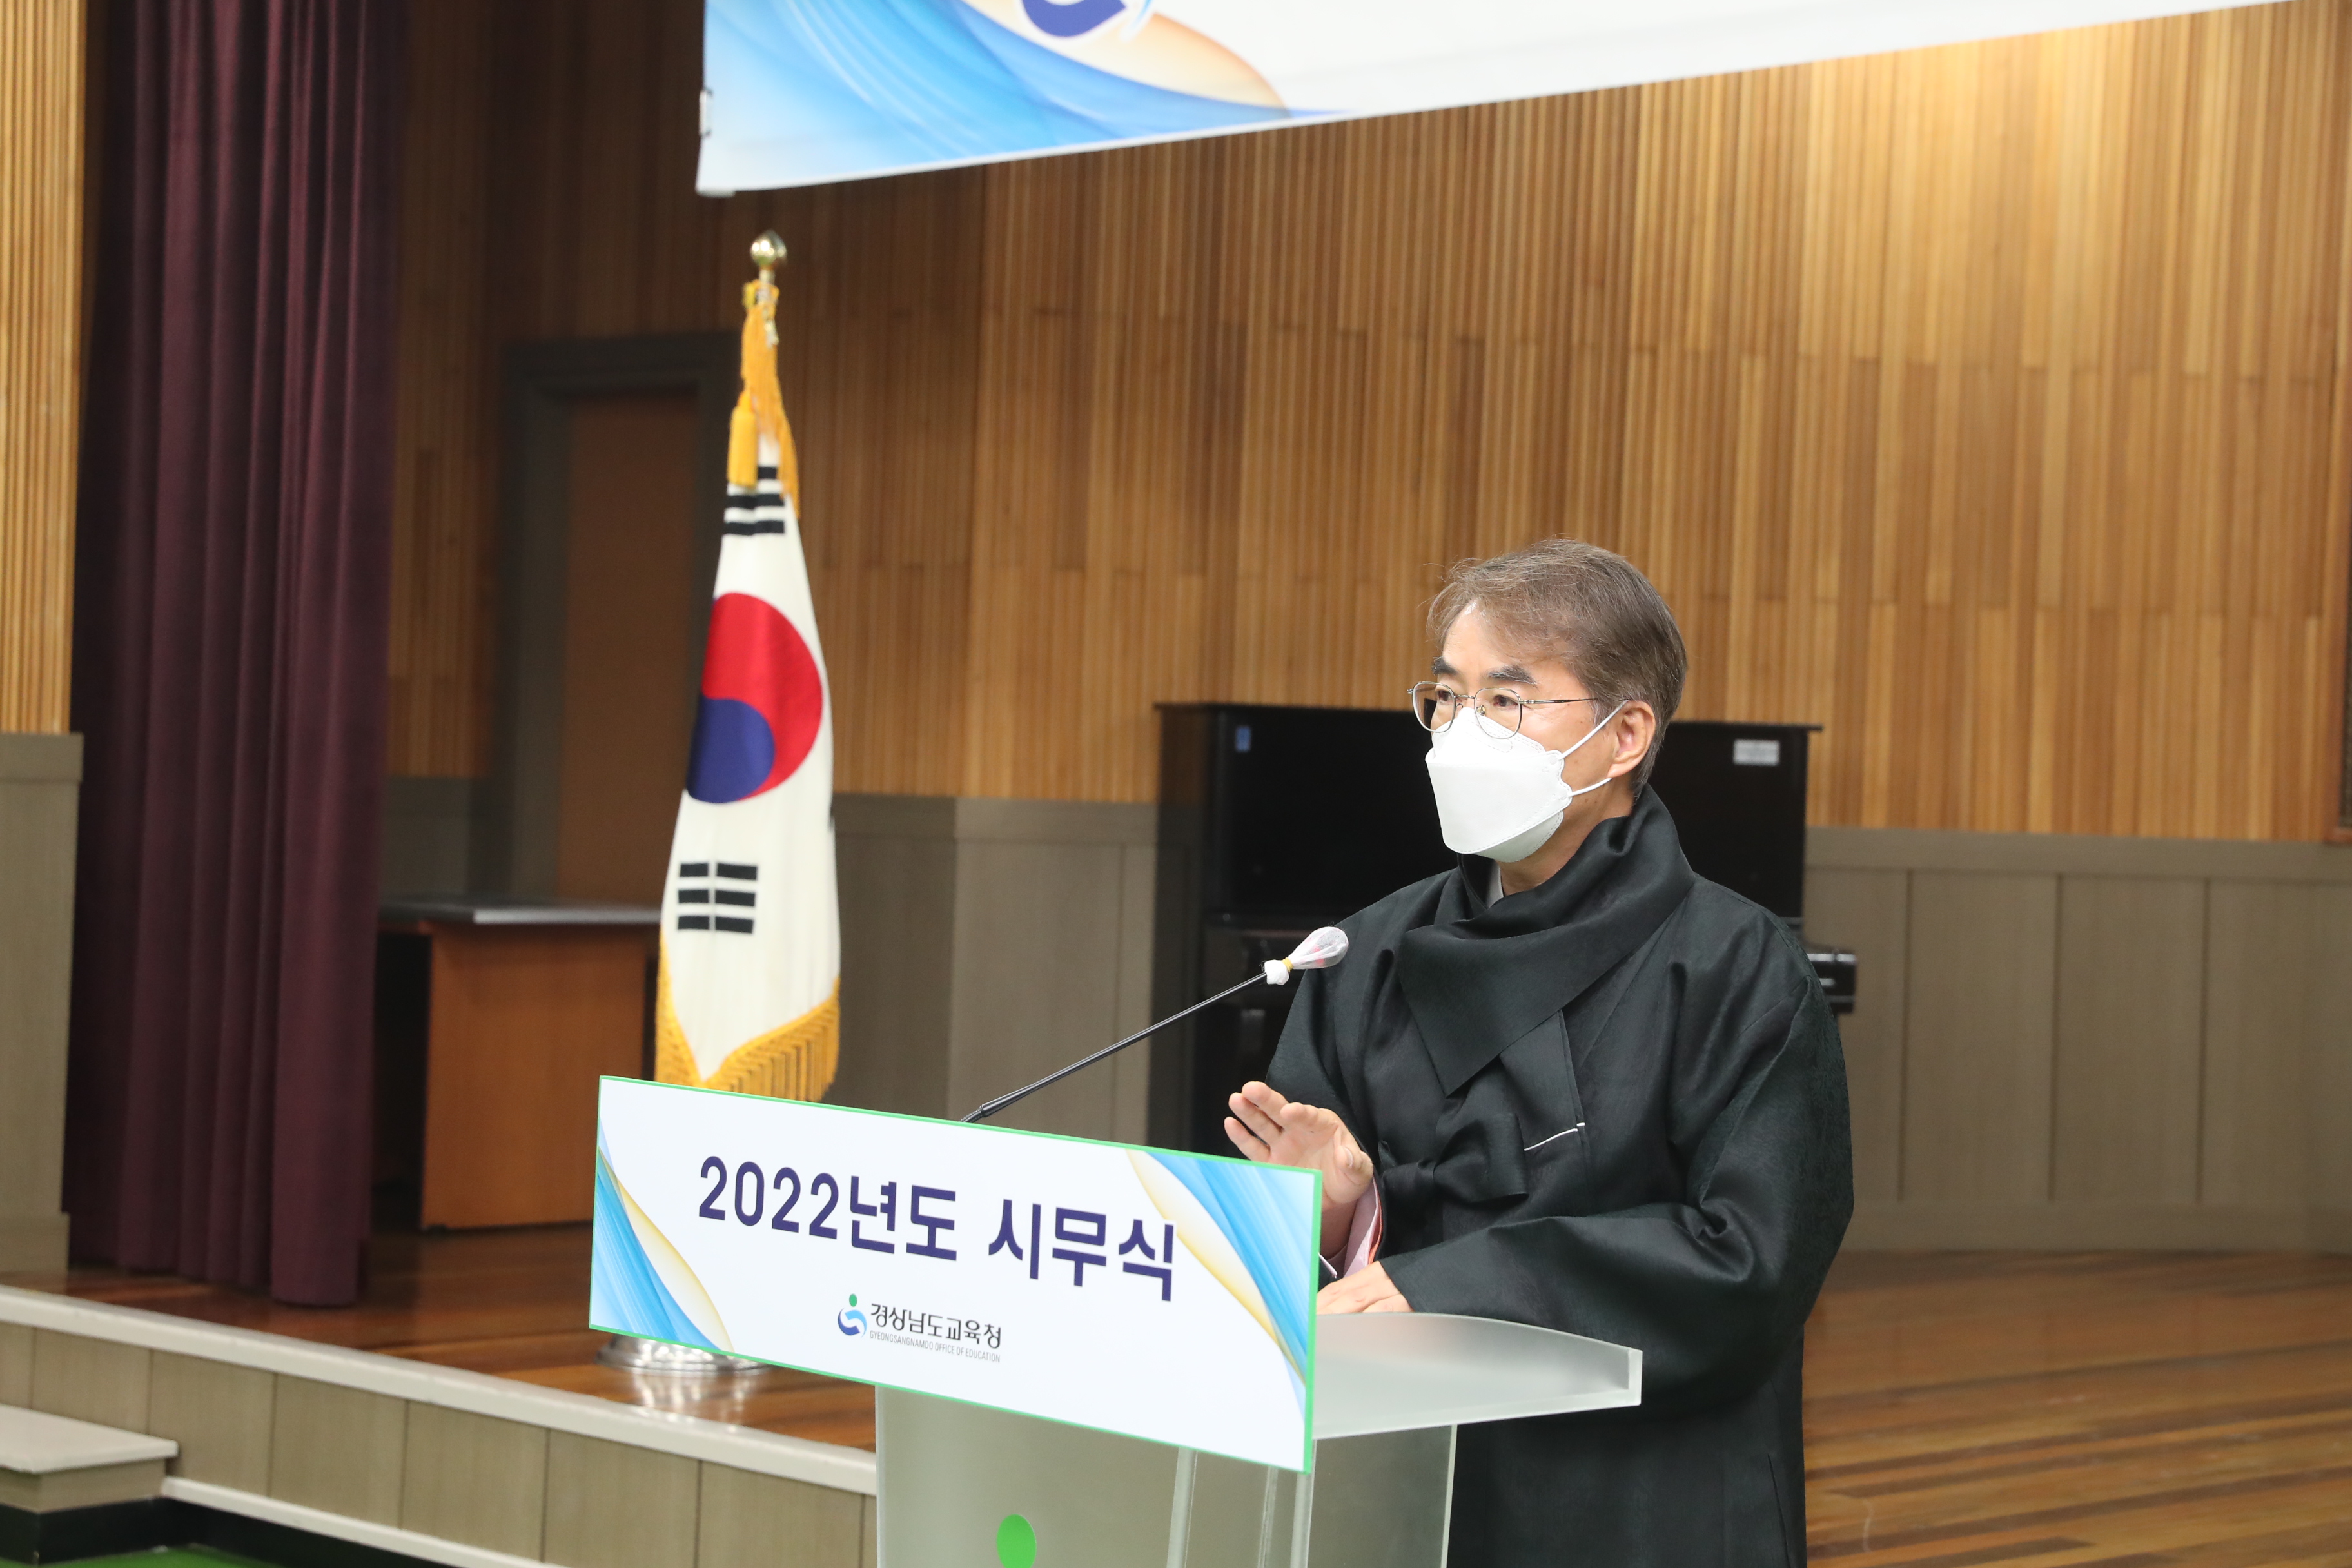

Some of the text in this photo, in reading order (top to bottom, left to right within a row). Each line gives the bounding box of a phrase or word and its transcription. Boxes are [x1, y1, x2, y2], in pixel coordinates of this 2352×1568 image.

[698, 1156, 1175, 1302] 2022년도 시무식
[870, 1303, 1001, 1349] 경상남도교육청
[870, 1330, 1001, 1363] GYEONGSANGNAMDO OFFICE OF EDUCATION
